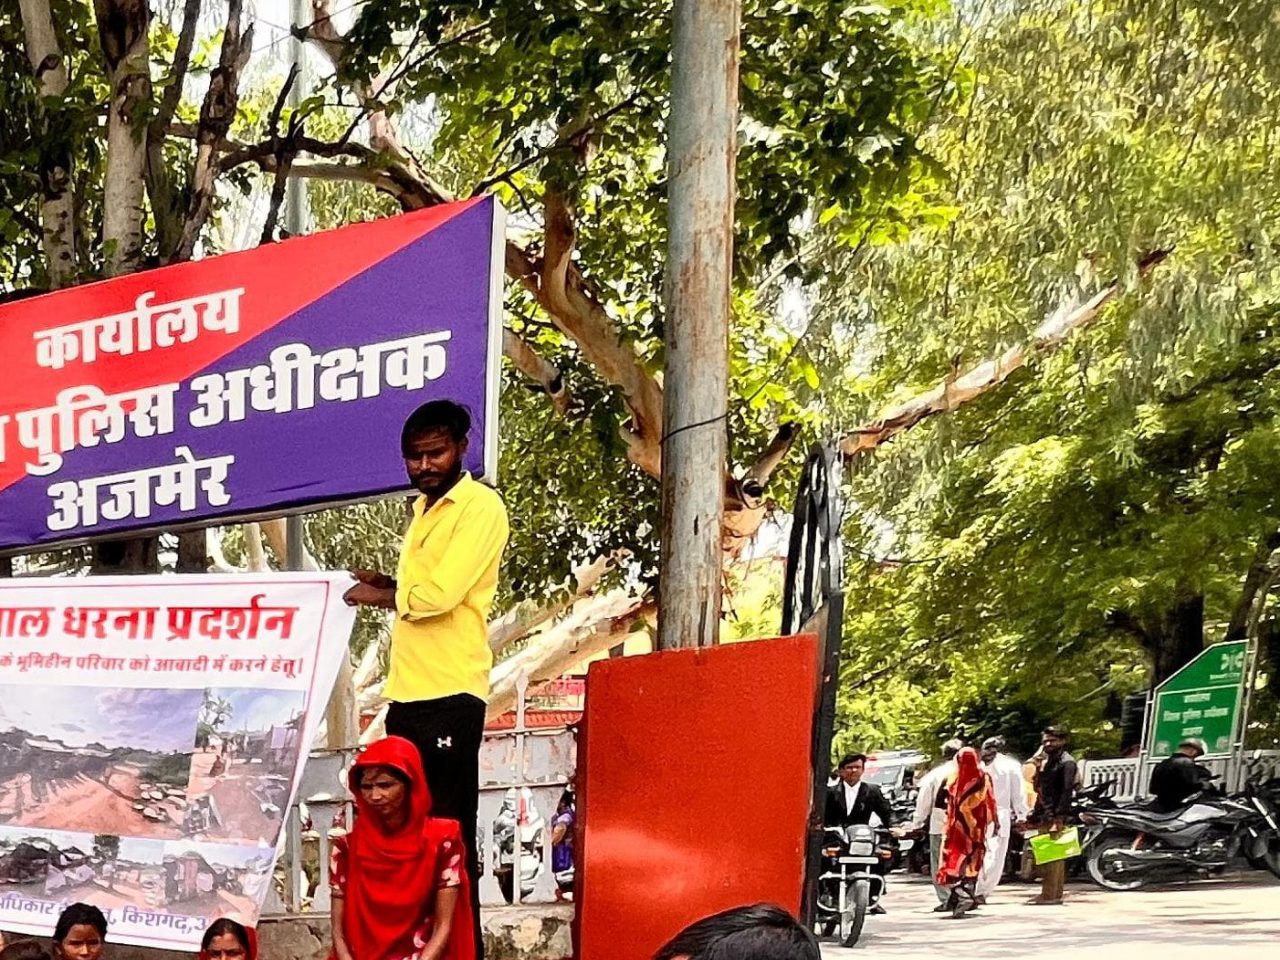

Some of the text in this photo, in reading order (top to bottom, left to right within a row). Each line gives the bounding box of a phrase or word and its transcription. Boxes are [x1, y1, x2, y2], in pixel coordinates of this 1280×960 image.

[33, 290, 245, 370] कार्यालय
[16, 385, 180, 477] पुलिस
[189, 329, 452, 429] अधीक्षक
[46, 447, 235, 532] अजमेर
[63, 606, 161, 639] धरना
[166, 593, 300, 641] प्रदर्शन
[17, 652, 72, 672] भूमिहीन
[75, 653, 125, 670] परिवार
[154, 655, 210, 672] आबादी
[228, 655, 268, 672] करने
